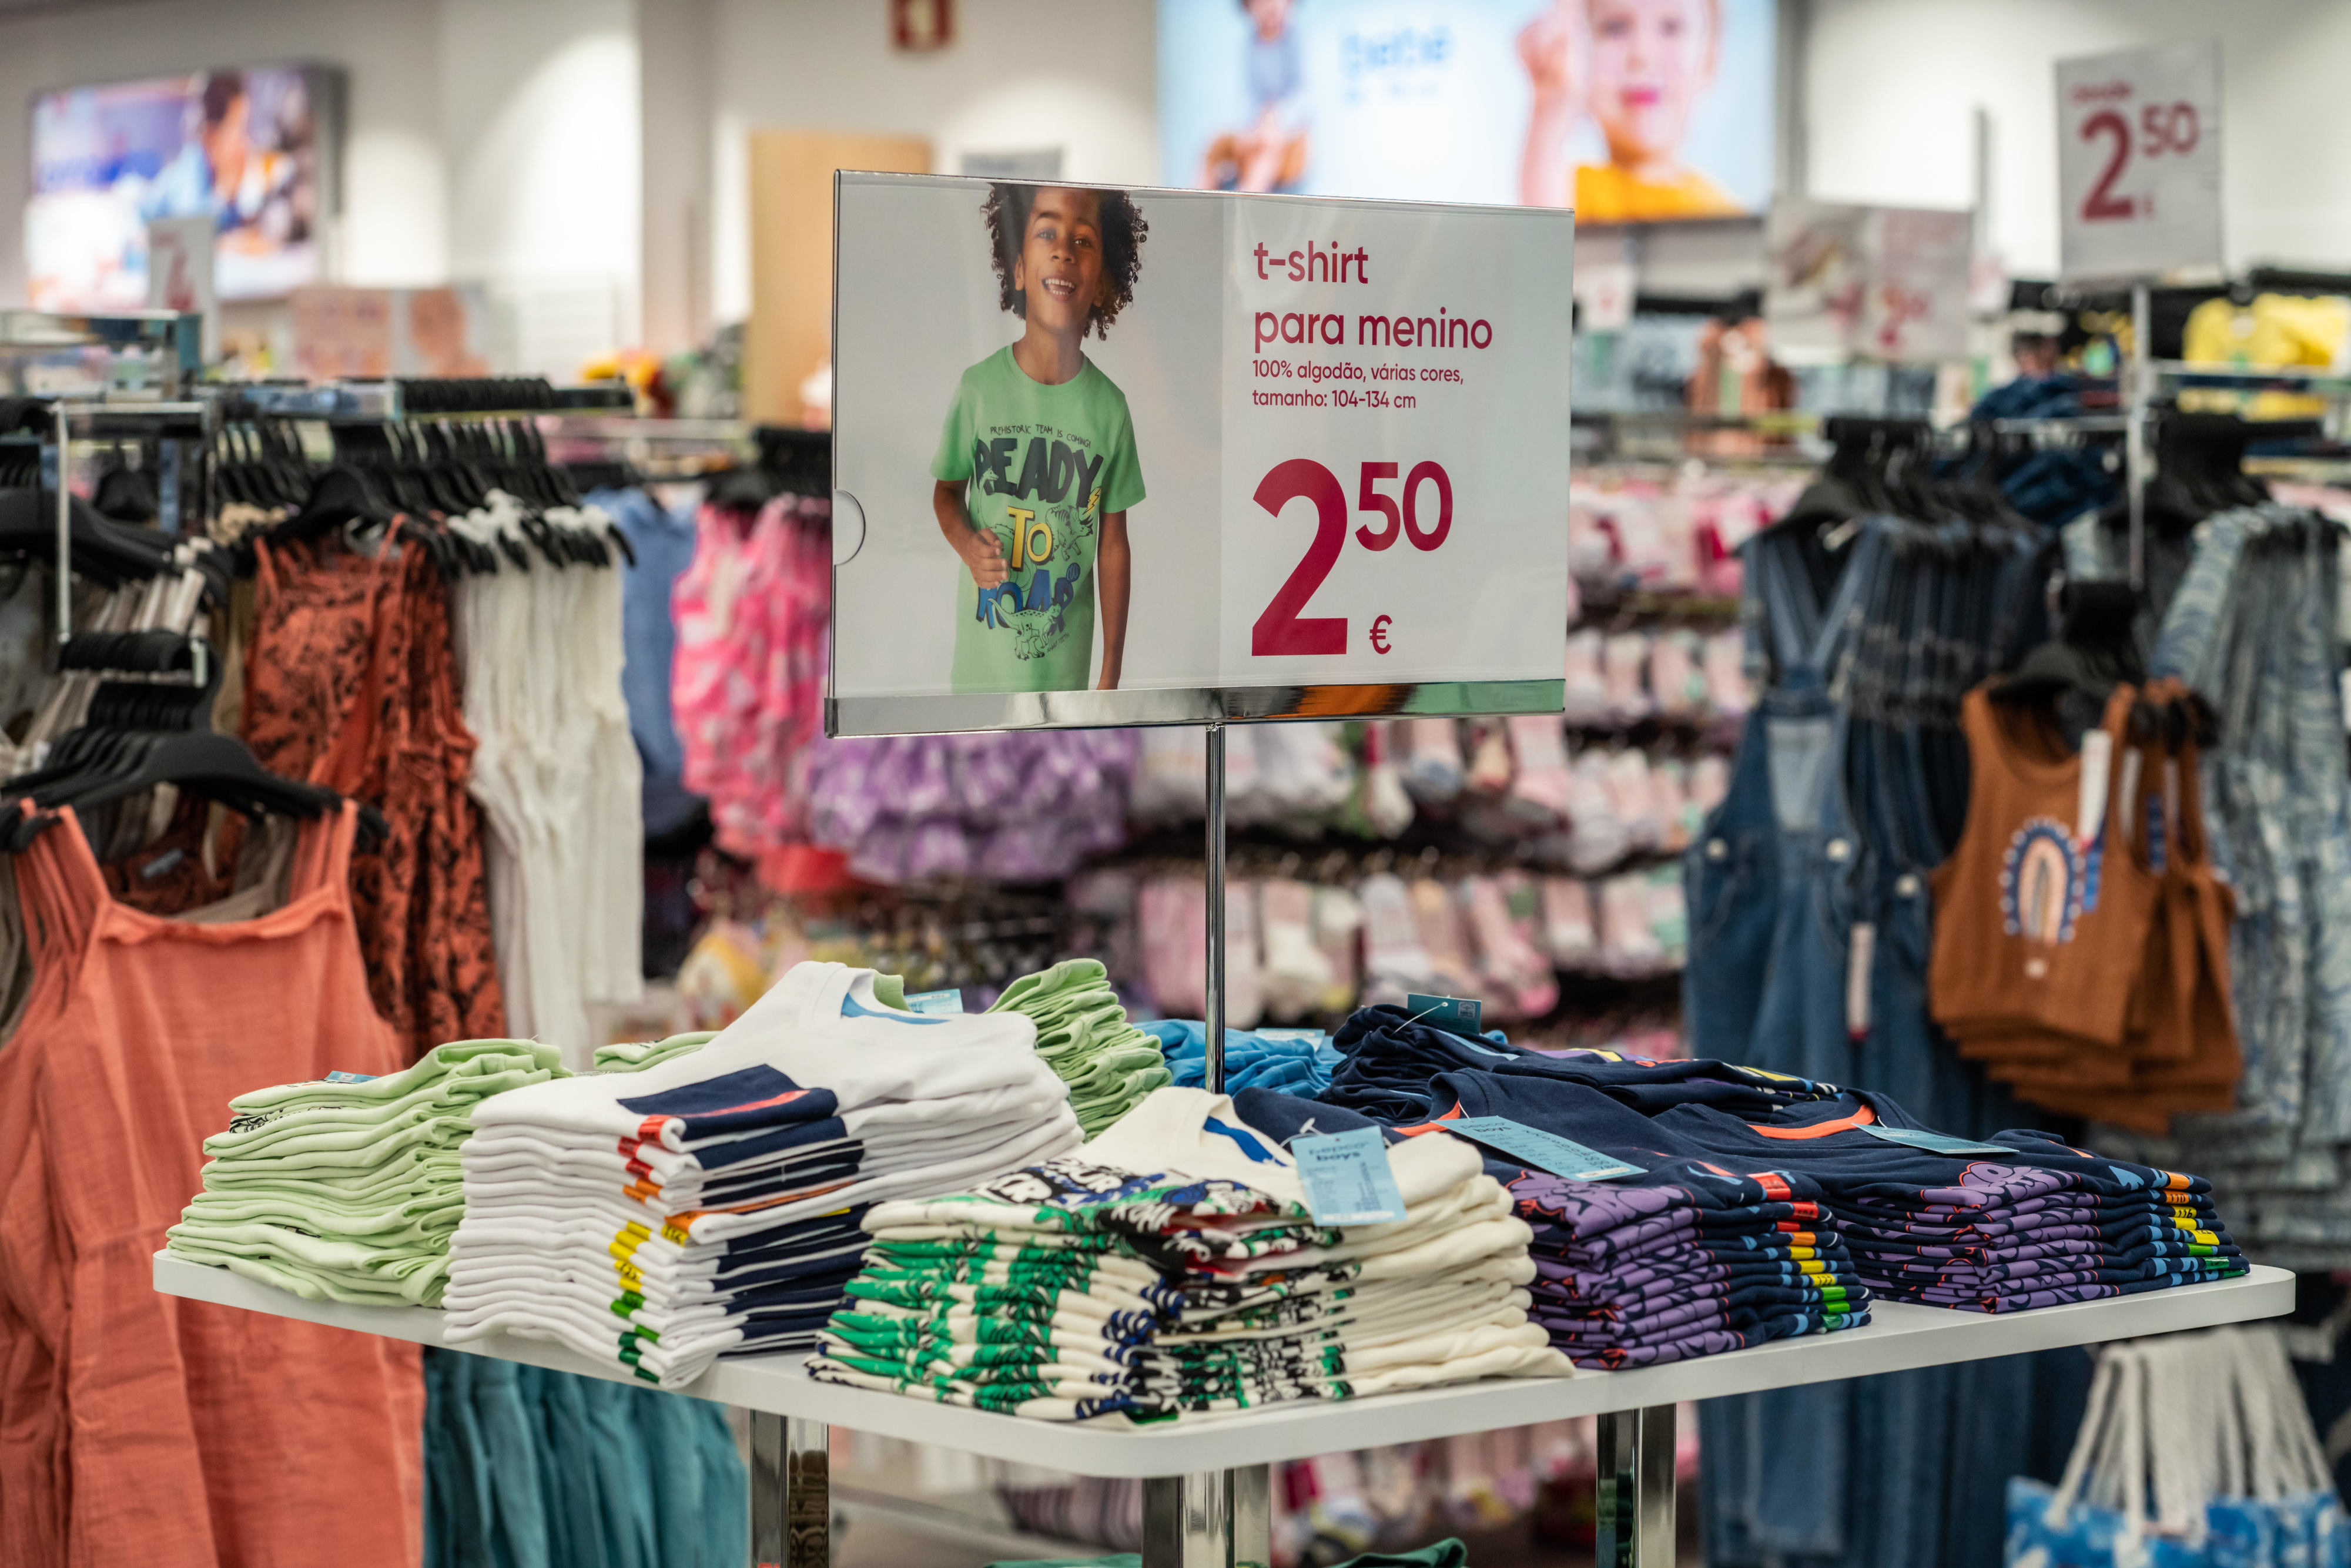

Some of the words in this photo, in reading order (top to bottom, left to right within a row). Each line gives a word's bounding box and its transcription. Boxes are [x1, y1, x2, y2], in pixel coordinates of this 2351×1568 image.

[2080, 109, 2134, 221] 2
[2141, 102, 2199, 157] 50
[1253, 240, 1369, 284] t-shirt
[1255, 311, 1344, 354] para
[1358, 306, 1492, 349] menino
[1252, 359, 1292, 378] 100%
[1297, 359, 1366, 384] algodão,
[1371, 362, 1416, 381] várias
[1420, 368, 1463, 385] cores,
[1252, 390, 1328, 407] tamanho:
[1331, 390, 1390, 408] 104-134
[1394, 396, 1416, 408] cm
[990, 424, 1032, 436] PREHISTORIC
[1036, 423, 1053, 435] TEAM
[1057, 429, 1063, 438] IS
[974, 437, 1104, 508] READY
[1007, 506, 1056, 572] TO
[1251, 458, 1348, 656] 2
[1355, 460, 1454, 552] 50
[1369, 614, 1392, 655] €
